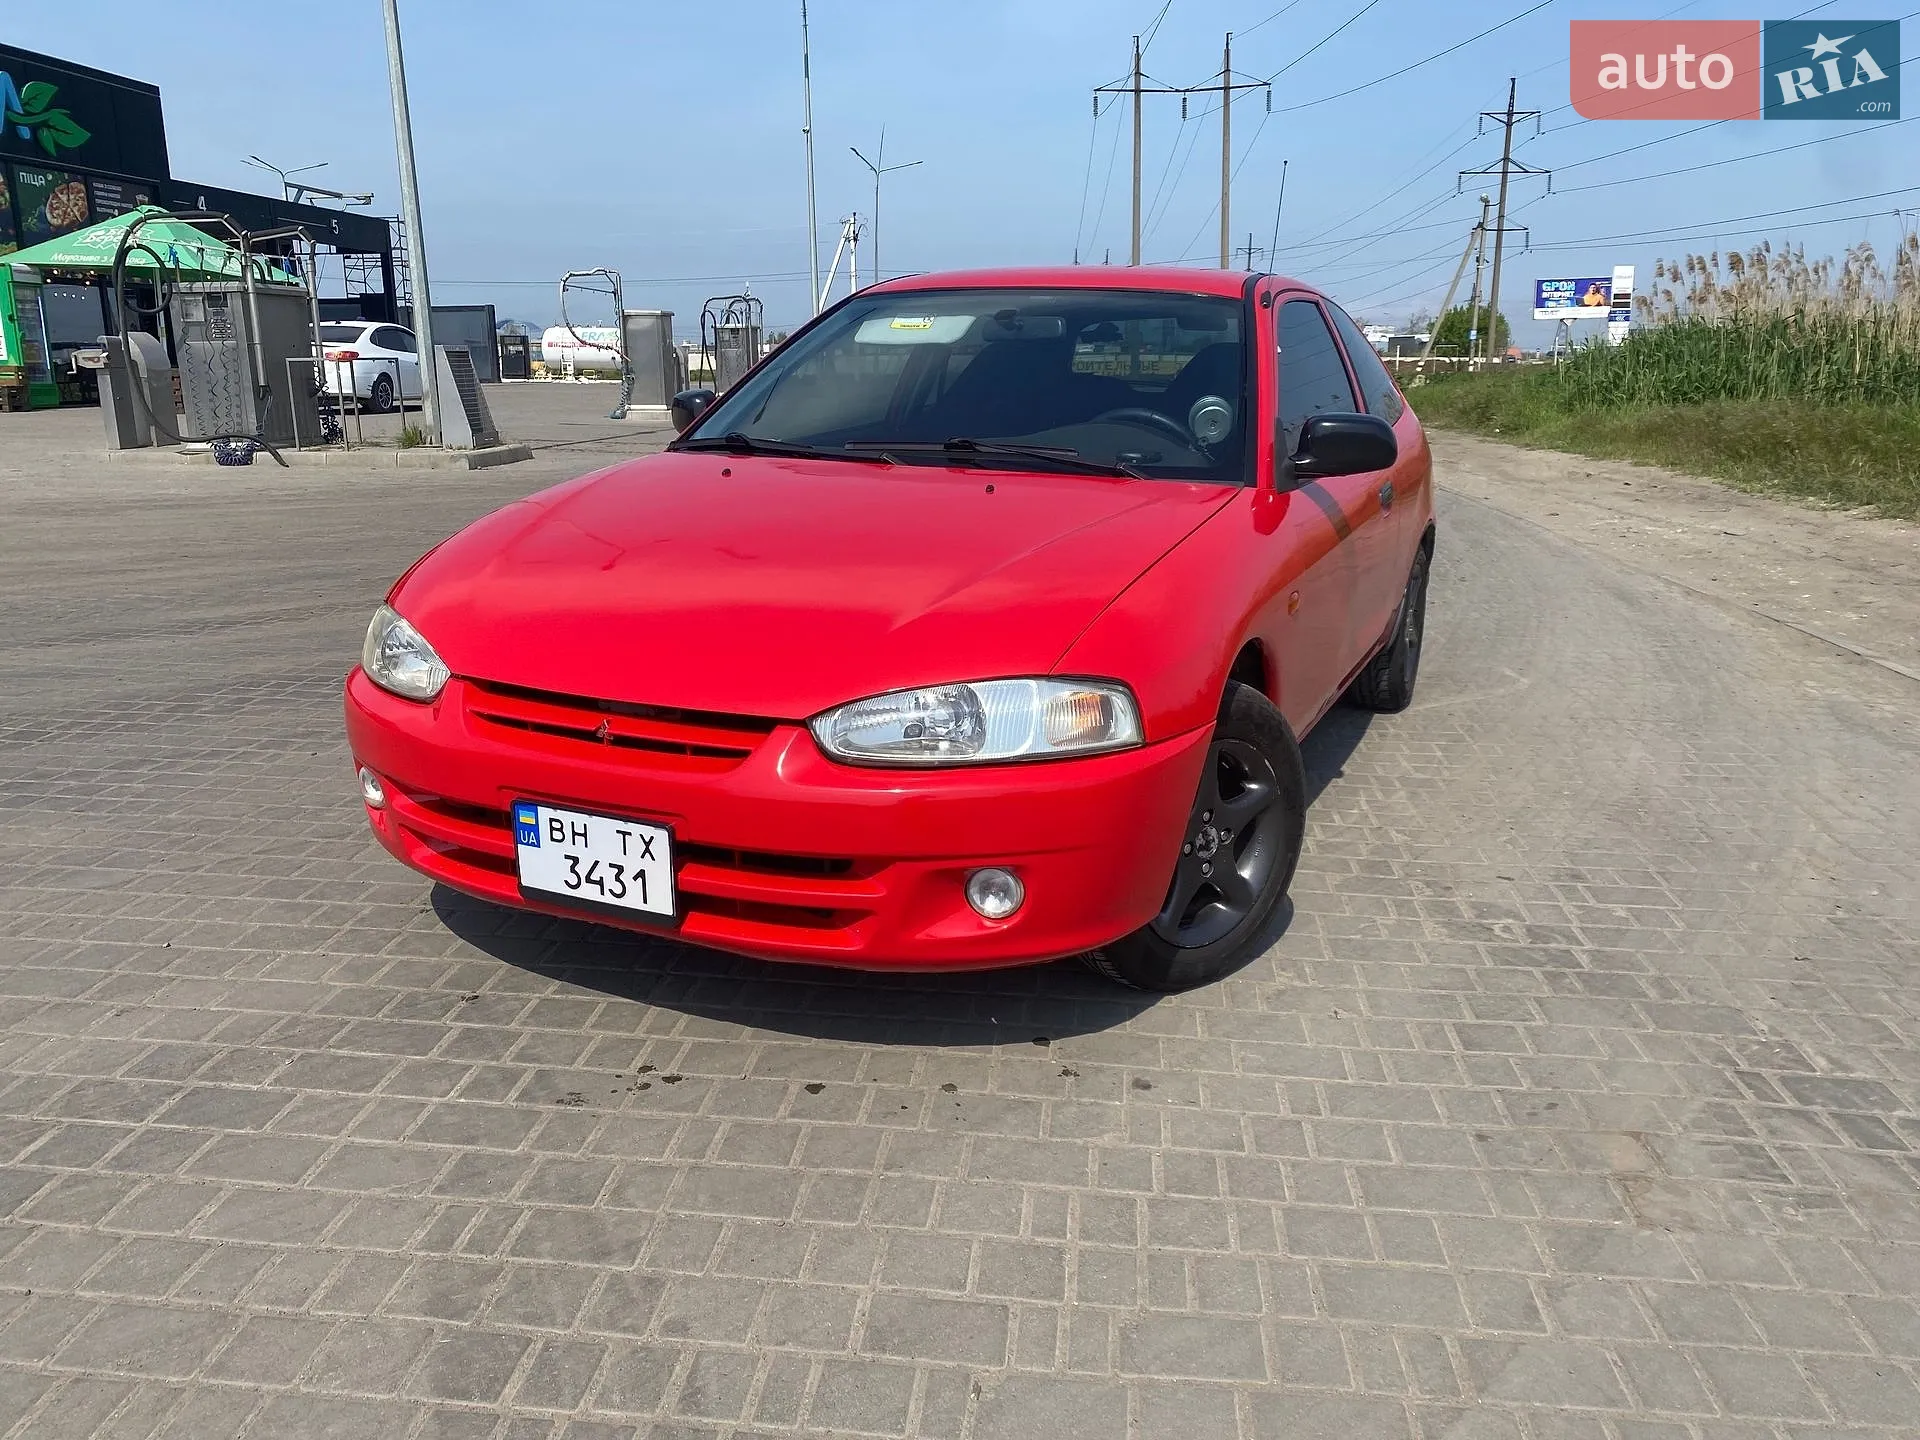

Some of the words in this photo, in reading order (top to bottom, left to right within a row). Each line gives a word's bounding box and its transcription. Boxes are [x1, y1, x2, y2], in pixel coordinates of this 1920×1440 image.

[19, 172, 46, 187] ПІЦА
[196, 195, 207, 212] 4
[332, 219, 340, 235] 5
[1542, 281, 1576, 291] GPON
[520, 830, 538, 846] UA
[548, 817, 588, 848] BH
[615, 830, 656, 861] TX
[563, 854, 648, 905] 3431
